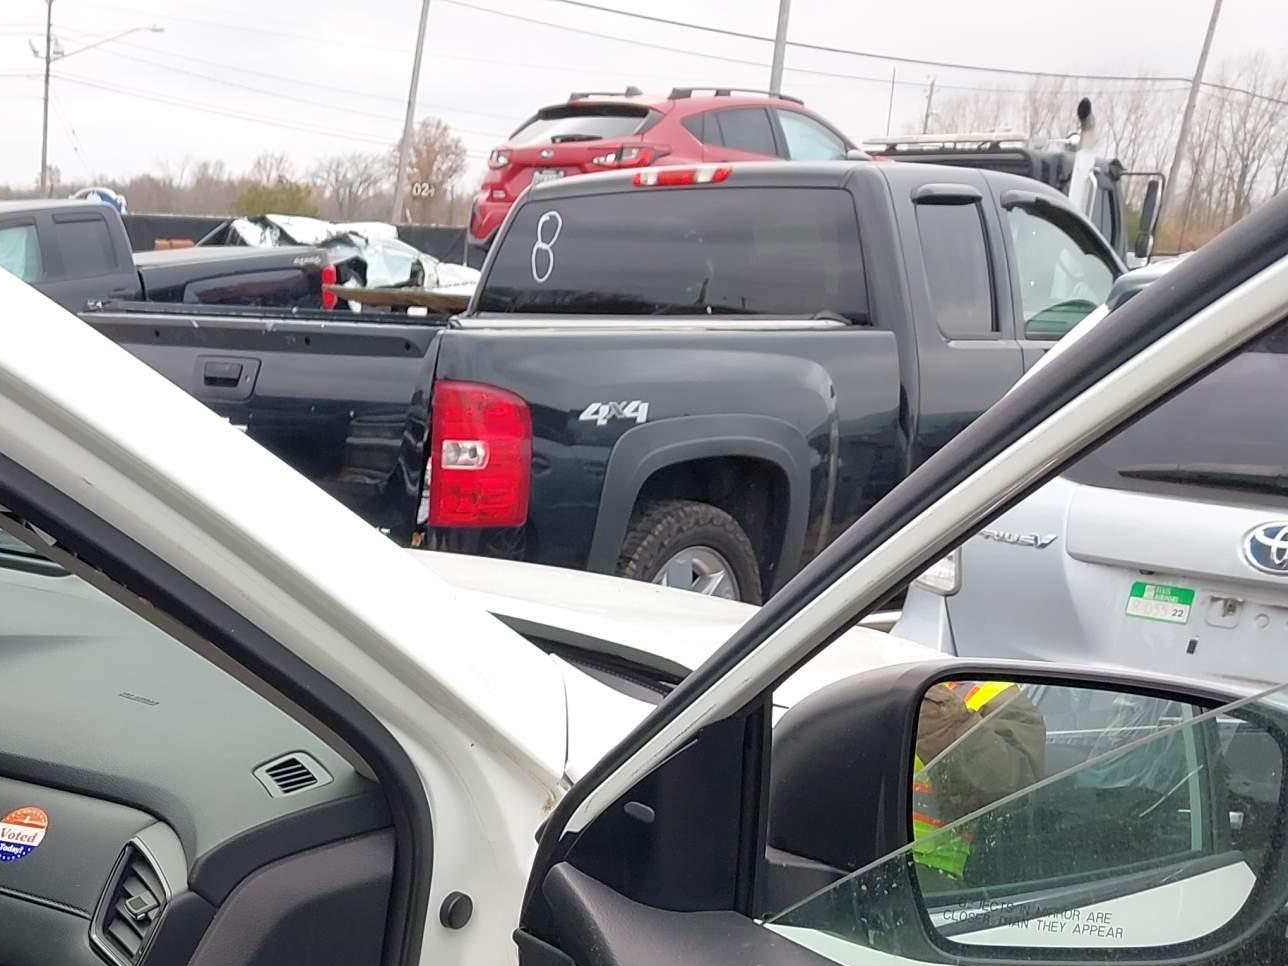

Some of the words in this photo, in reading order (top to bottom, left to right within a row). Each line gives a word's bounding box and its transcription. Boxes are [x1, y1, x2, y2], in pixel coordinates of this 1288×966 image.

[532, 211, 562, 282] 8
[1172, 608, 1184, 617] 22
[0, 827, 38, 843] Voted
[1086, 911, 1113, 924] ARE
[1036, 919, 1068, 934] THEY
[1071, 923, 1125, 939] APPEAR
